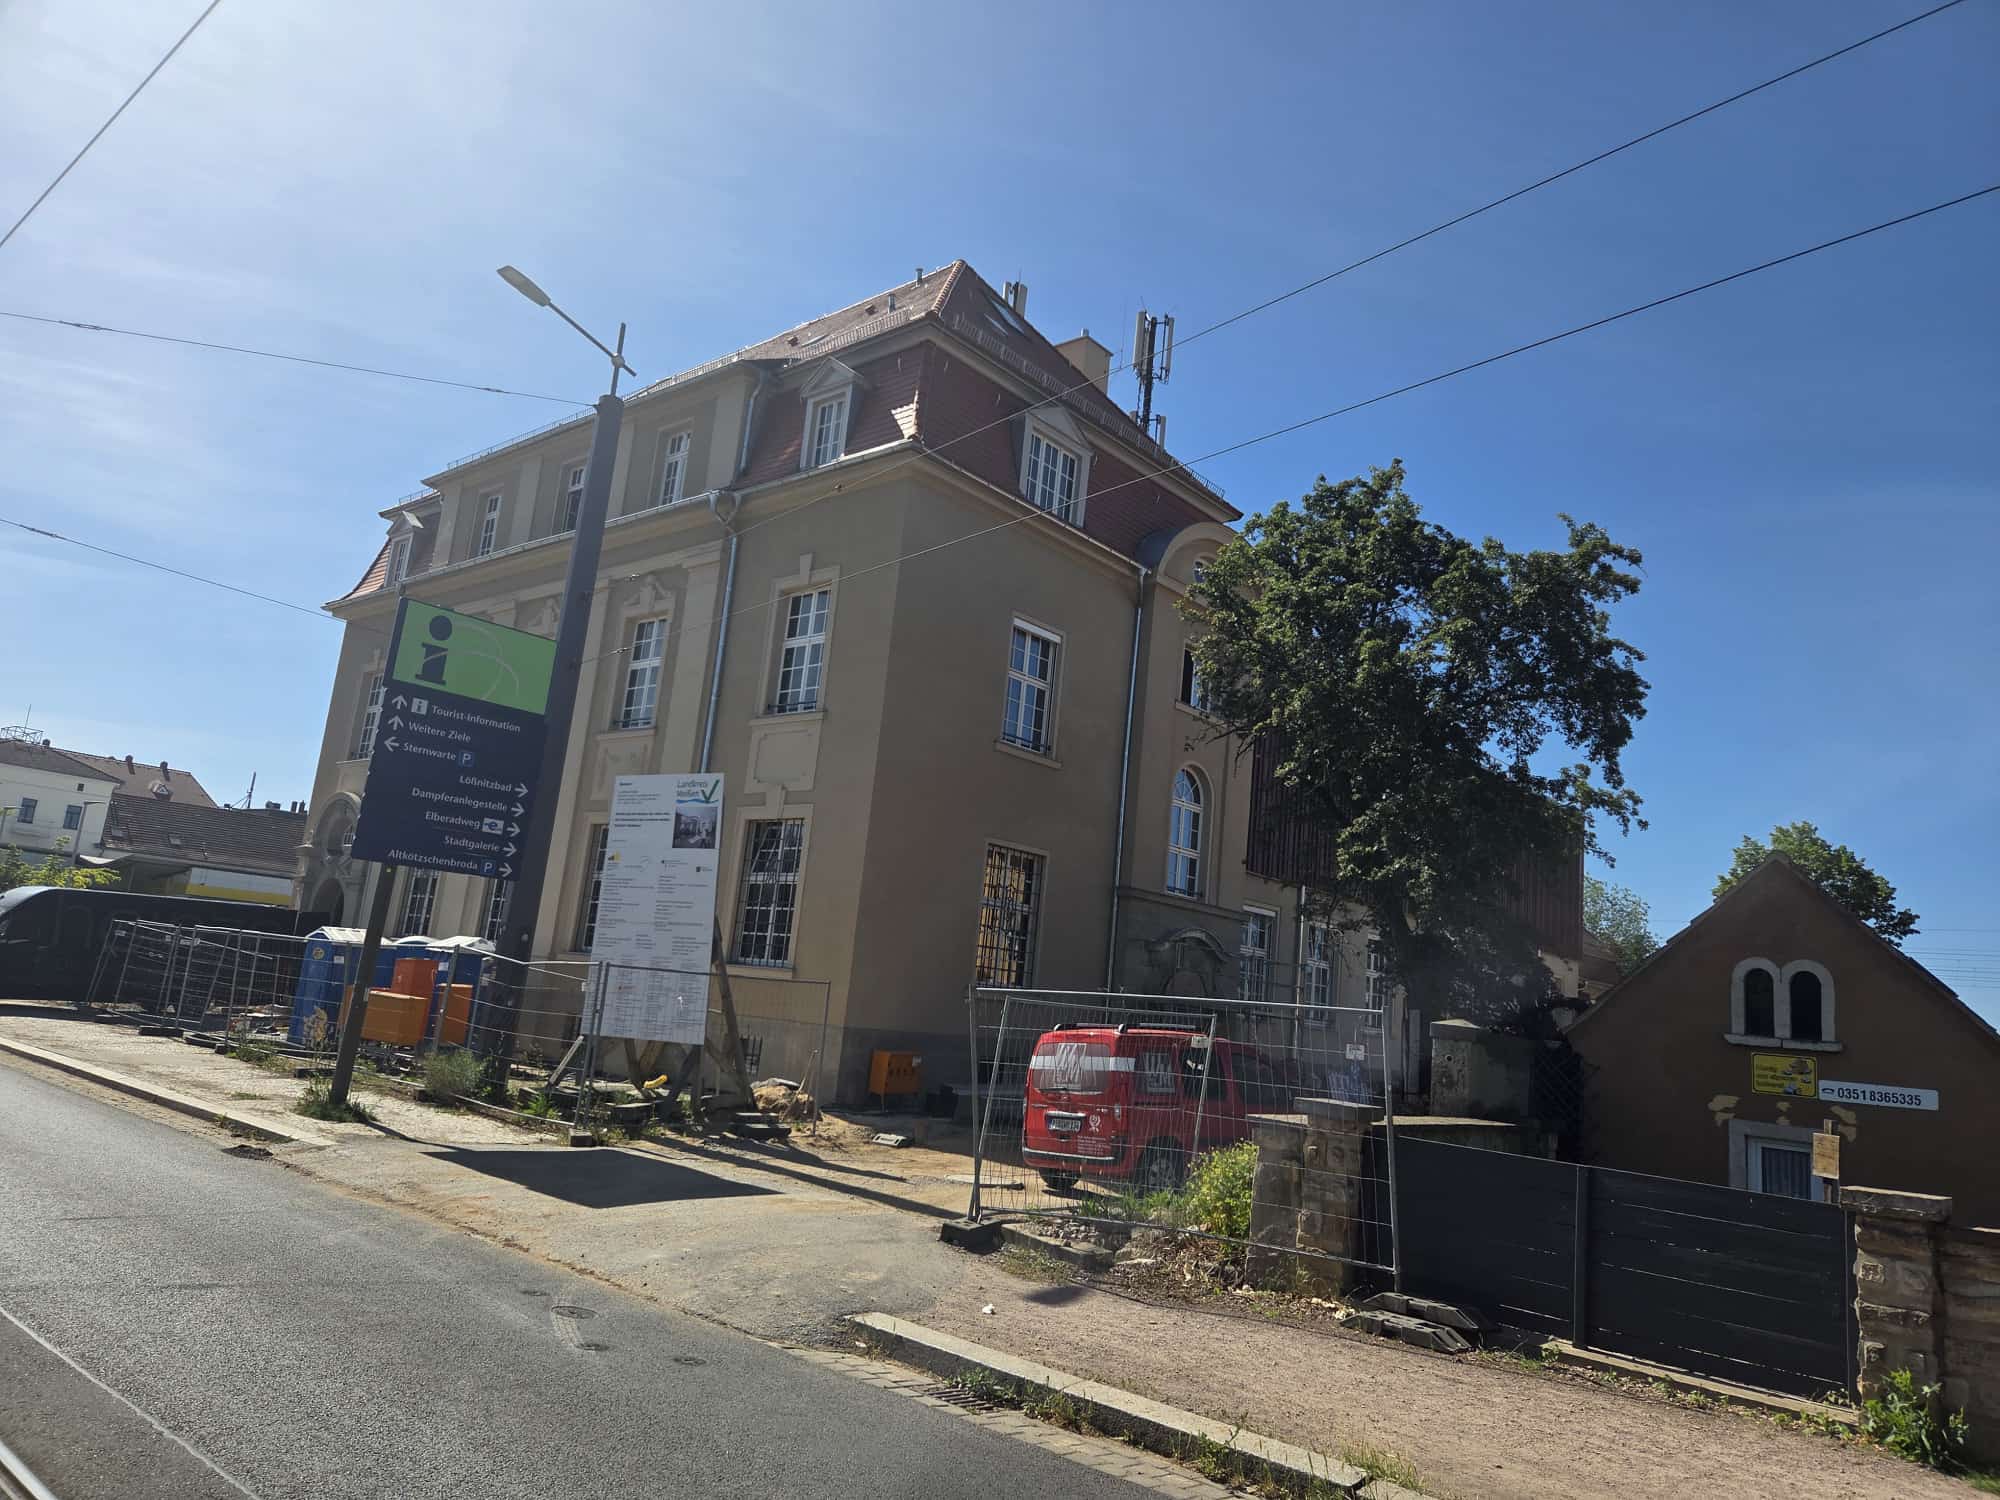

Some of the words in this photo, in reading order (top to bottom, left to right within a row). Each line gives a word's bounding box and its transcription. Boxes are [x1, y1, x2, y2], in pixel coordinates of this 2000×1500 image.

[431, 705, 521, 733] Tourist-Information
[409, 721, 446, 737] Weitere
[447, 730, 471, 743] Ziele
[403, 742, 457, 761] Sternwarte
[411, 787, 508, 811] Dampferanlegestelle
[425, 811, 481, 829] Elberadweg
[444, 835, 500, 852] Stadtgalerie
[1837, 1087, 1866, 1101] 0351
[1869, 1090, 1922, 1106] 8365335
